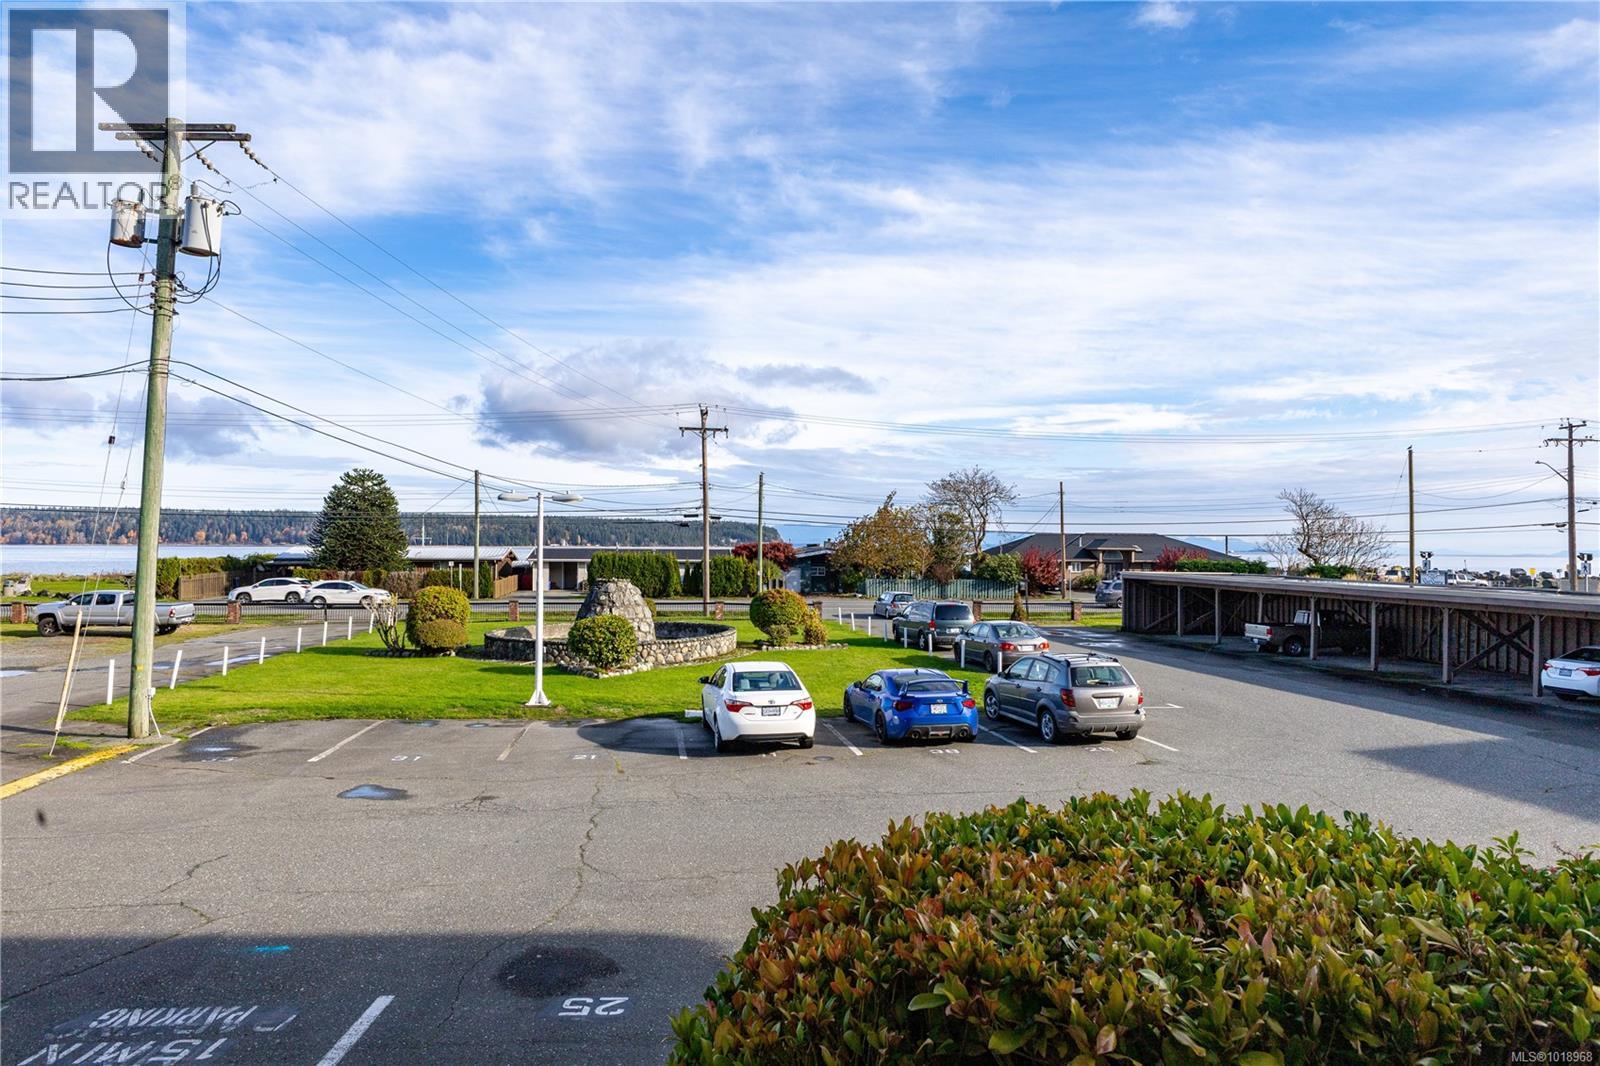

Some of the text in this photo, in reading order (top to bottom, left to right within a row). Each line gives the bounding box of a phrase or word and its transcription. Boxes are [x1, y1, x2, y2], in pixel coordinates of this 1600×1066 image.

[89, 1005, 259, 1032] PARKING
[558, 997, 629, 1016] 25
[17, 1037, 228, 1066] 15 MIN
